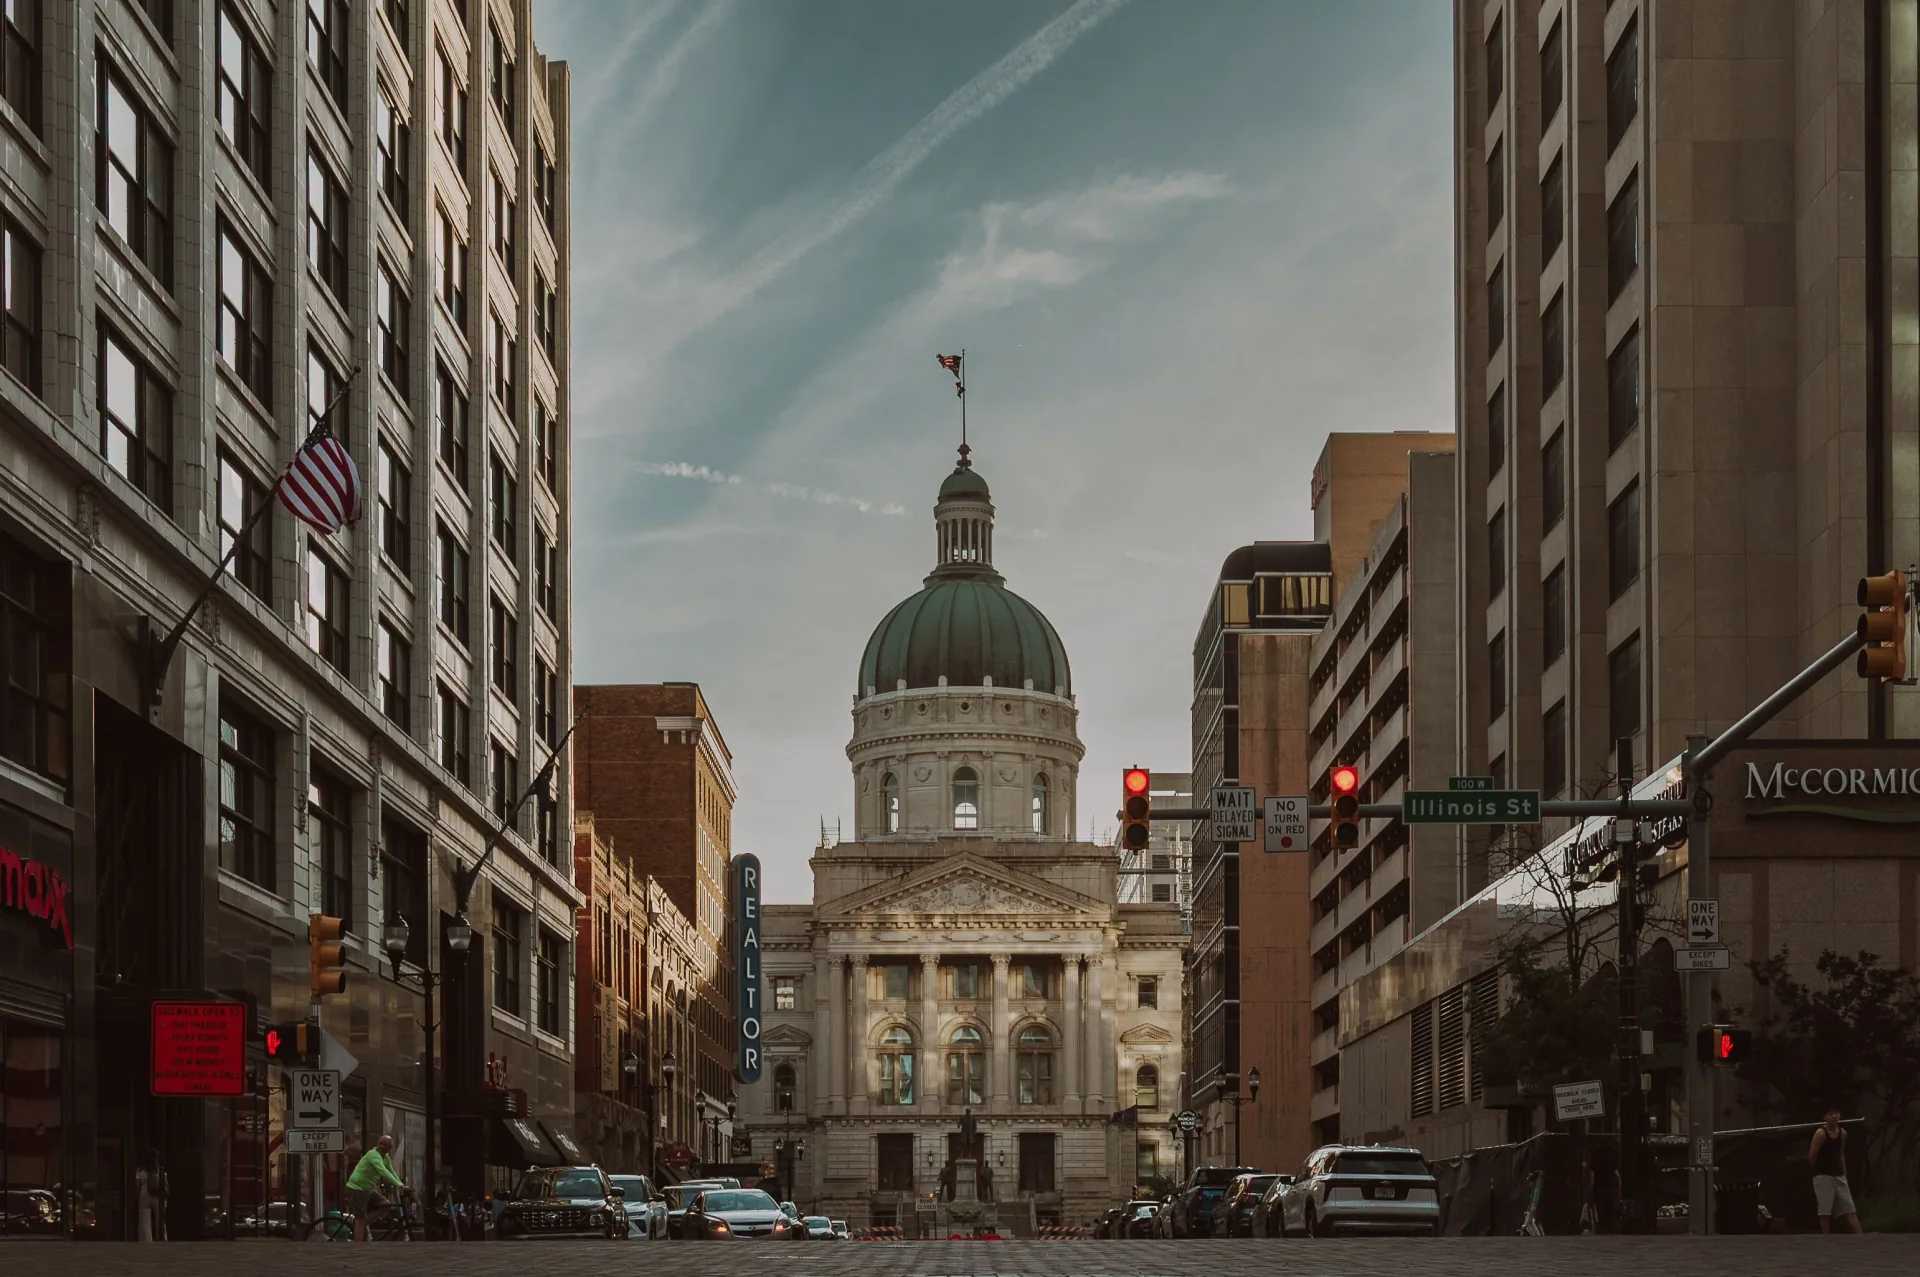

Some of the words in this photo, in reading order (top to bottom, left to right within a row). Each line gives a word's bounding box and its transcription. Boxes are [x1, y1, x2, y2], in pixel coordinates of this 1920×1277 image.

[1457, 780, 1474, 789] 100
[1477, 780, 1485, 789] W
[1216, 791, 1250, 808] WAIT
[1276, 800, 1295, 811] NO
[1411, 798, 1497, 816] Illinois
[1507, 798, 1532, 815] St
[1213, 810, 1253, 823] DELAYED
[1273, 814, 1299, 823] TURN
[1216, 825, 1251, 838] SIGNAL
[1268, 825, 1281, 835] ON
[1286, 825, 1305, 834] RED
[0, 846, 74, 951] maxx
[1691, 902, 1715, 914] ONE
[1691, 915, 1715, 926] WAY
[1688, 951, 1716, 959] EXCEPT
[742, 867, 760, 1070] REALTOR
[1692, 960, 1713, 968] BIKES
[157, 1007, 199, 1016] SIDEWALK
[202, 1007, 226, 1016] OPEN
[229, 1007, 240, 1016] TO
[300, 1073, 331, 1087] ONE
[301, 1090, 333, 1103] WAY
[1556, 1090, 1578, 1098] SIDEWALK
[1581, 1087, 1600, 1095] CLOSED
[302, 1132, 331, 1141] EXCEPT
[305, 1142, 328, 1150] BIKES
